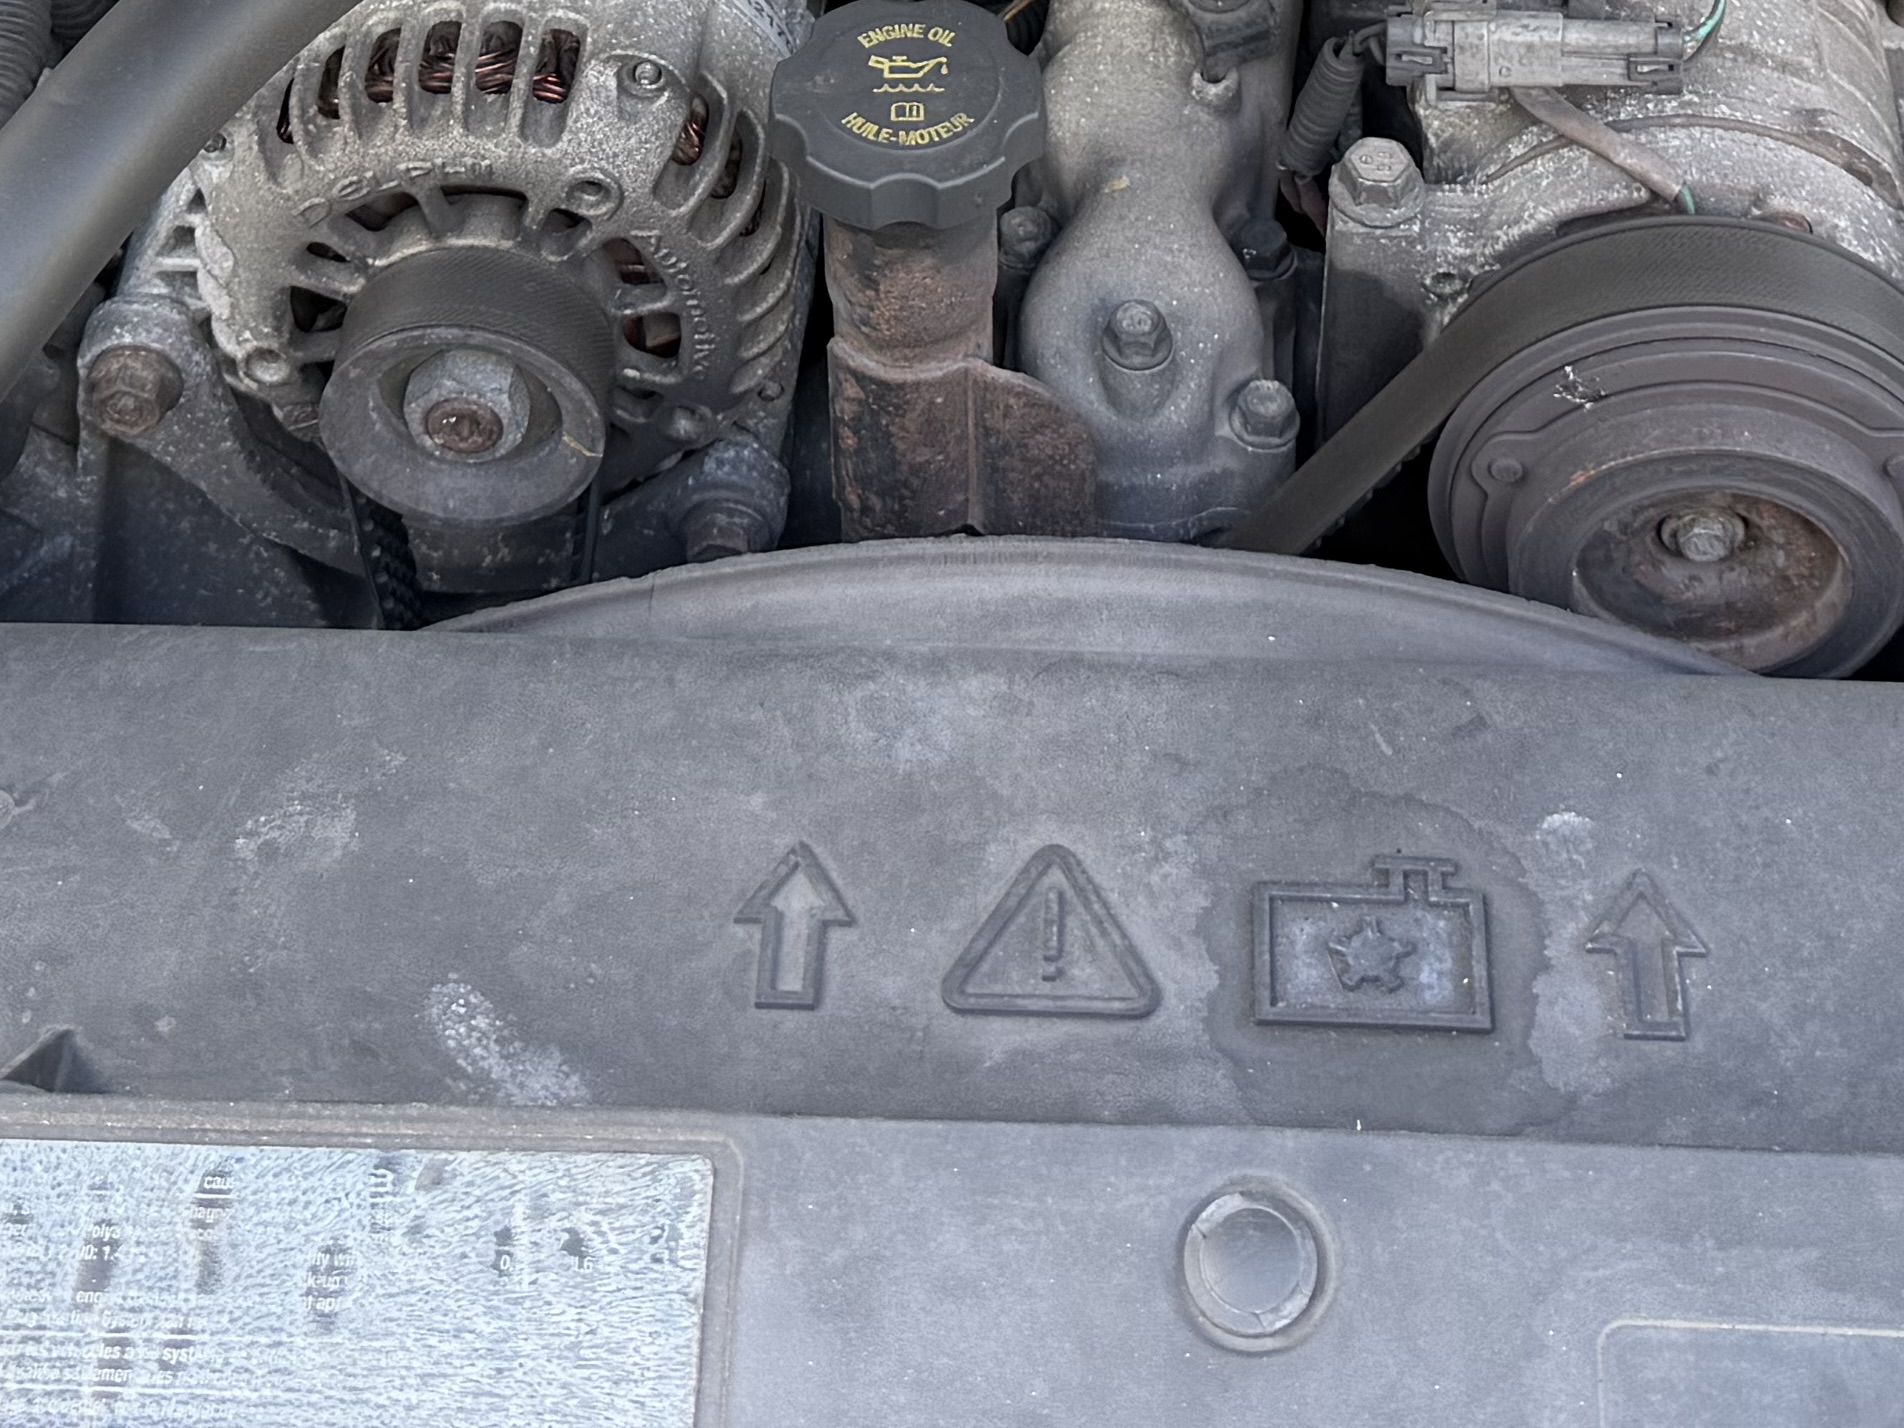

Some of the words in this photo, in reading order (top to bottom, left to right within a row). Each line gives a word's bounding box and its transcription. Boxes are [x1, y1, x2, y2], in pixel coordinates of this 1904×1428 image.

[857, 23, 927, 48] ENGINE
[927, 25, 957, 47] OIL
[841, 111, 975, 146] HUILE-MOTEUR
[629, 229, 716, 381] Automotive
